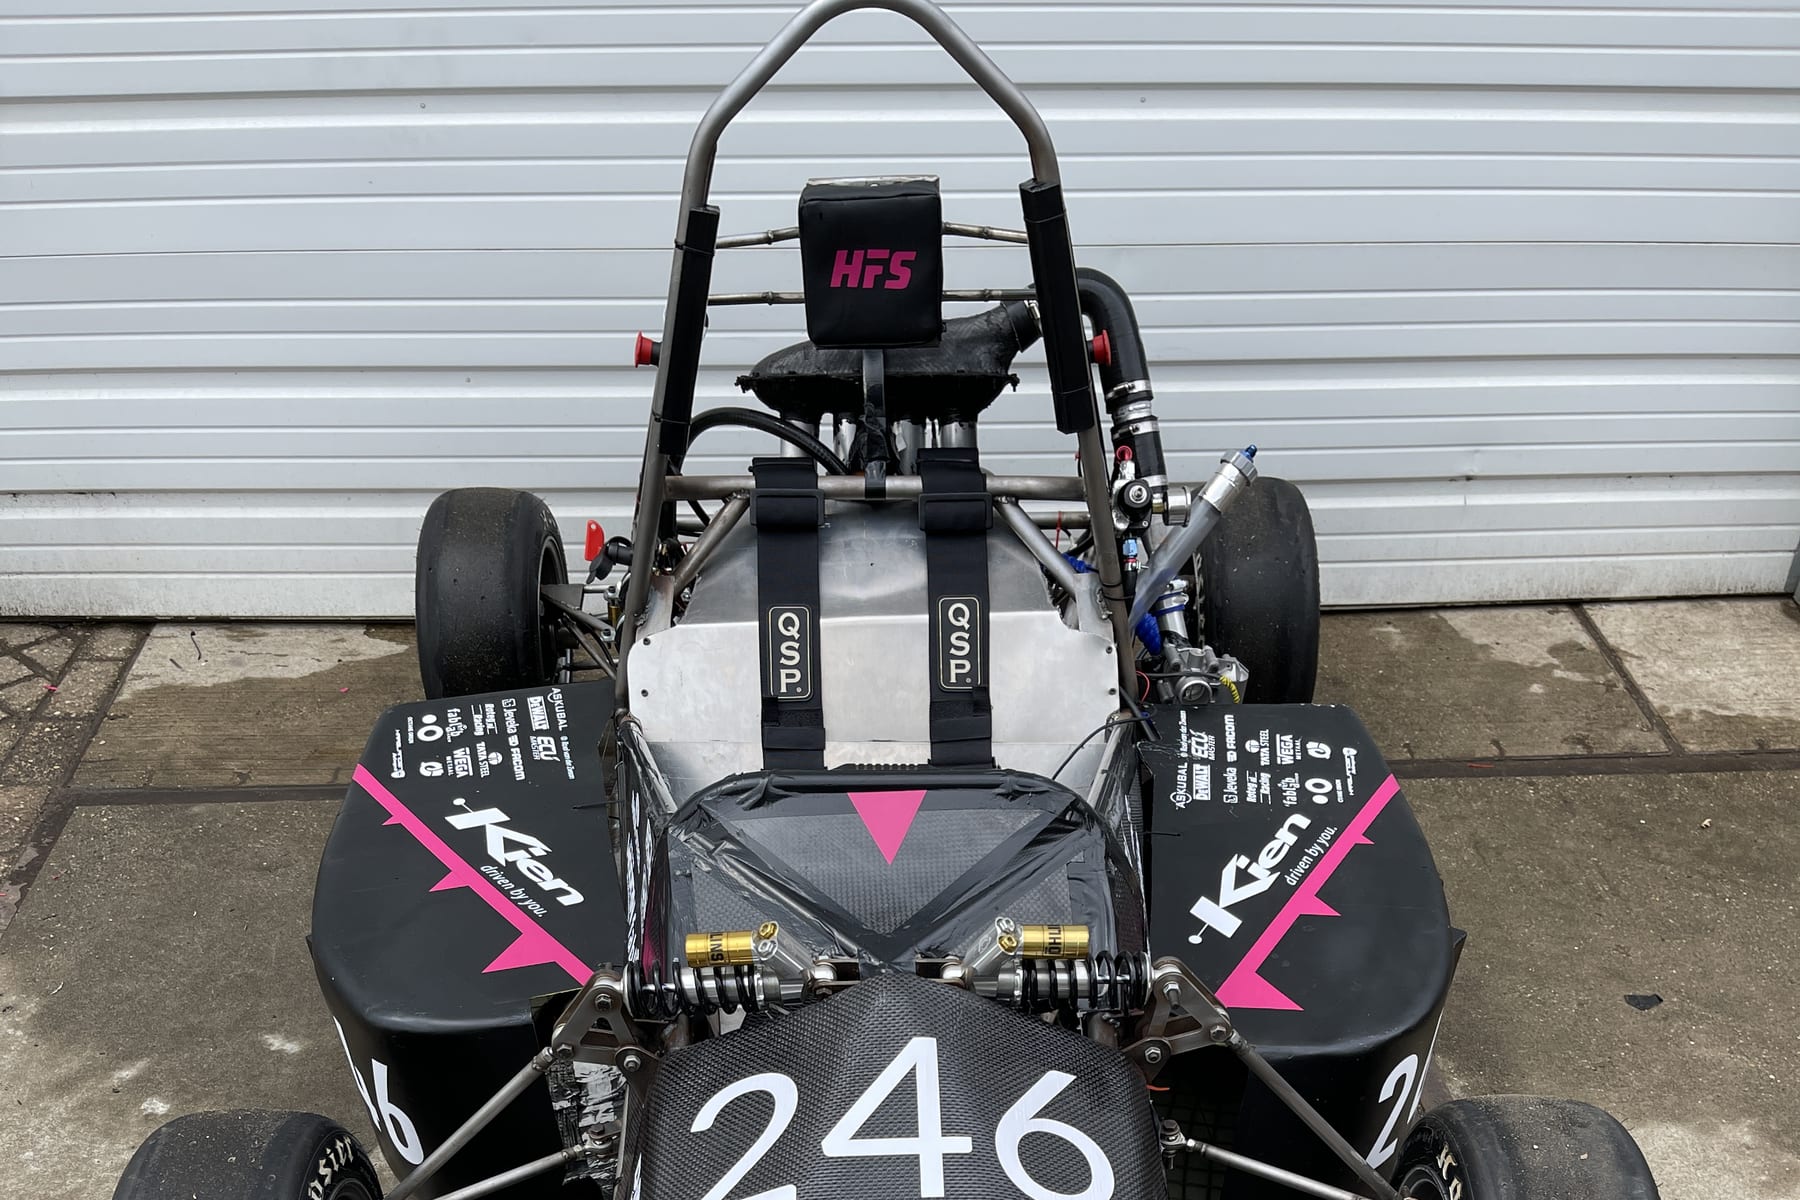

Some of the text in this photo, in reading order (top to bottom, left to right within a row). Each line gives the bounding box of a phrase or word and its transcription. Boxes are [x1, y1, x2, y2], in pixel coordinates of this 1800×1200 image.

[830, 249, 917, 290] HFS
[777, 611, 802, 693] QSP
[947, 602, 972, 684] QSP
[503, 708, 519, 734] Jeveka
[548, 687, 568, 731] ASKUBAL
[453, 748, 469, 778] WEGA
[476, 741, 490, 778] TATA STEEL
[1260, 729, 1270, 766] TATA STEEL
[1280, 734, 1294, 765] WEGA
[1173, 762, 1190, 809] ASKUBAL
[1223, 767, 1237, 794] Jeveka
[445, 807, 584, 906] Kien
[1190, 813, 1311, 938] Kien
[1284, 826, 1338, 886] driven by you.
[480, 865, 548, 918] driven by you.
